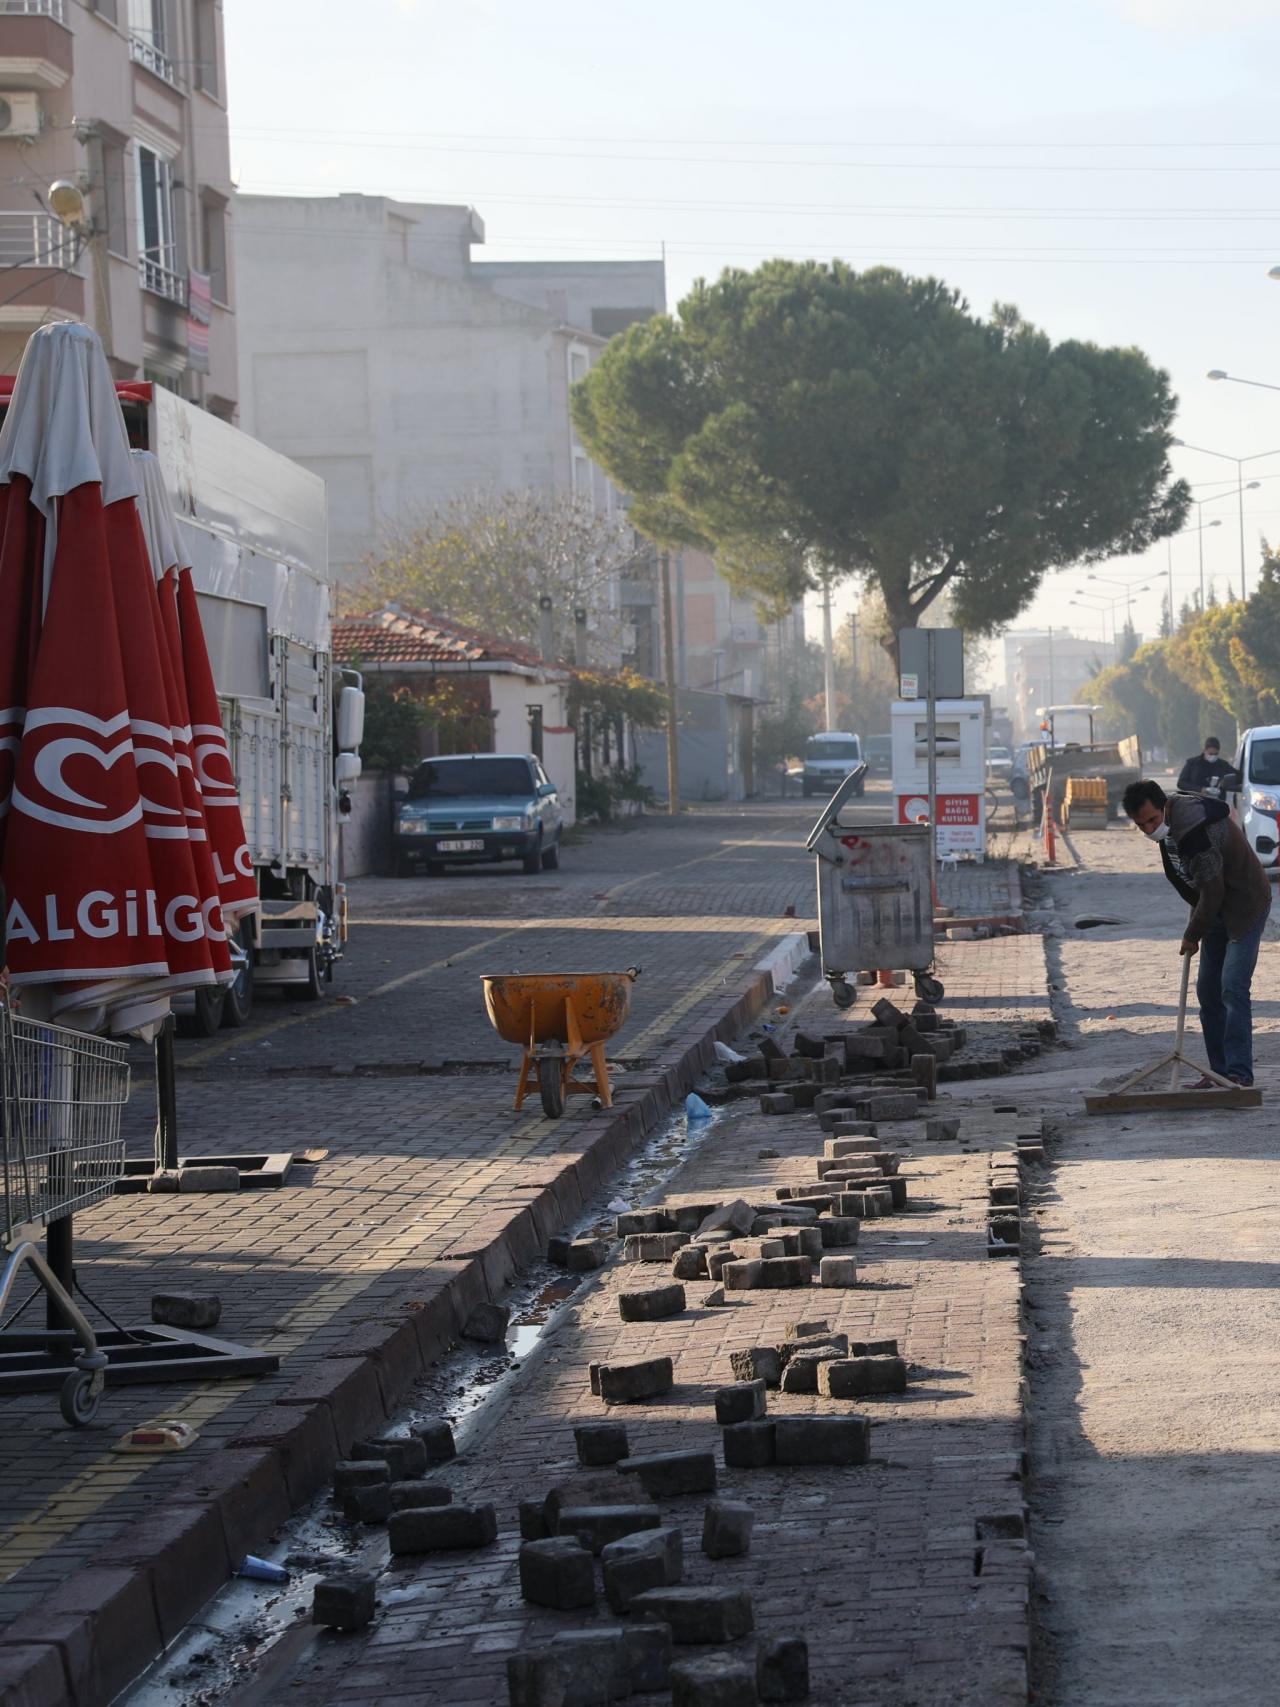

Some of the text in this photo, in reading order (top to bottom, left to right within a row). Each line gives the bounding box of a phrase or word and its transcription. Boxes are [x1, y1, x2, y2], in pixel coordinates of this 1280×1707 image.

[944, 798, 970, 806] GİYİM
[944, 806, 970, 815] BAĞIŞ
[941, 815, 974, 823] KUTUSU
